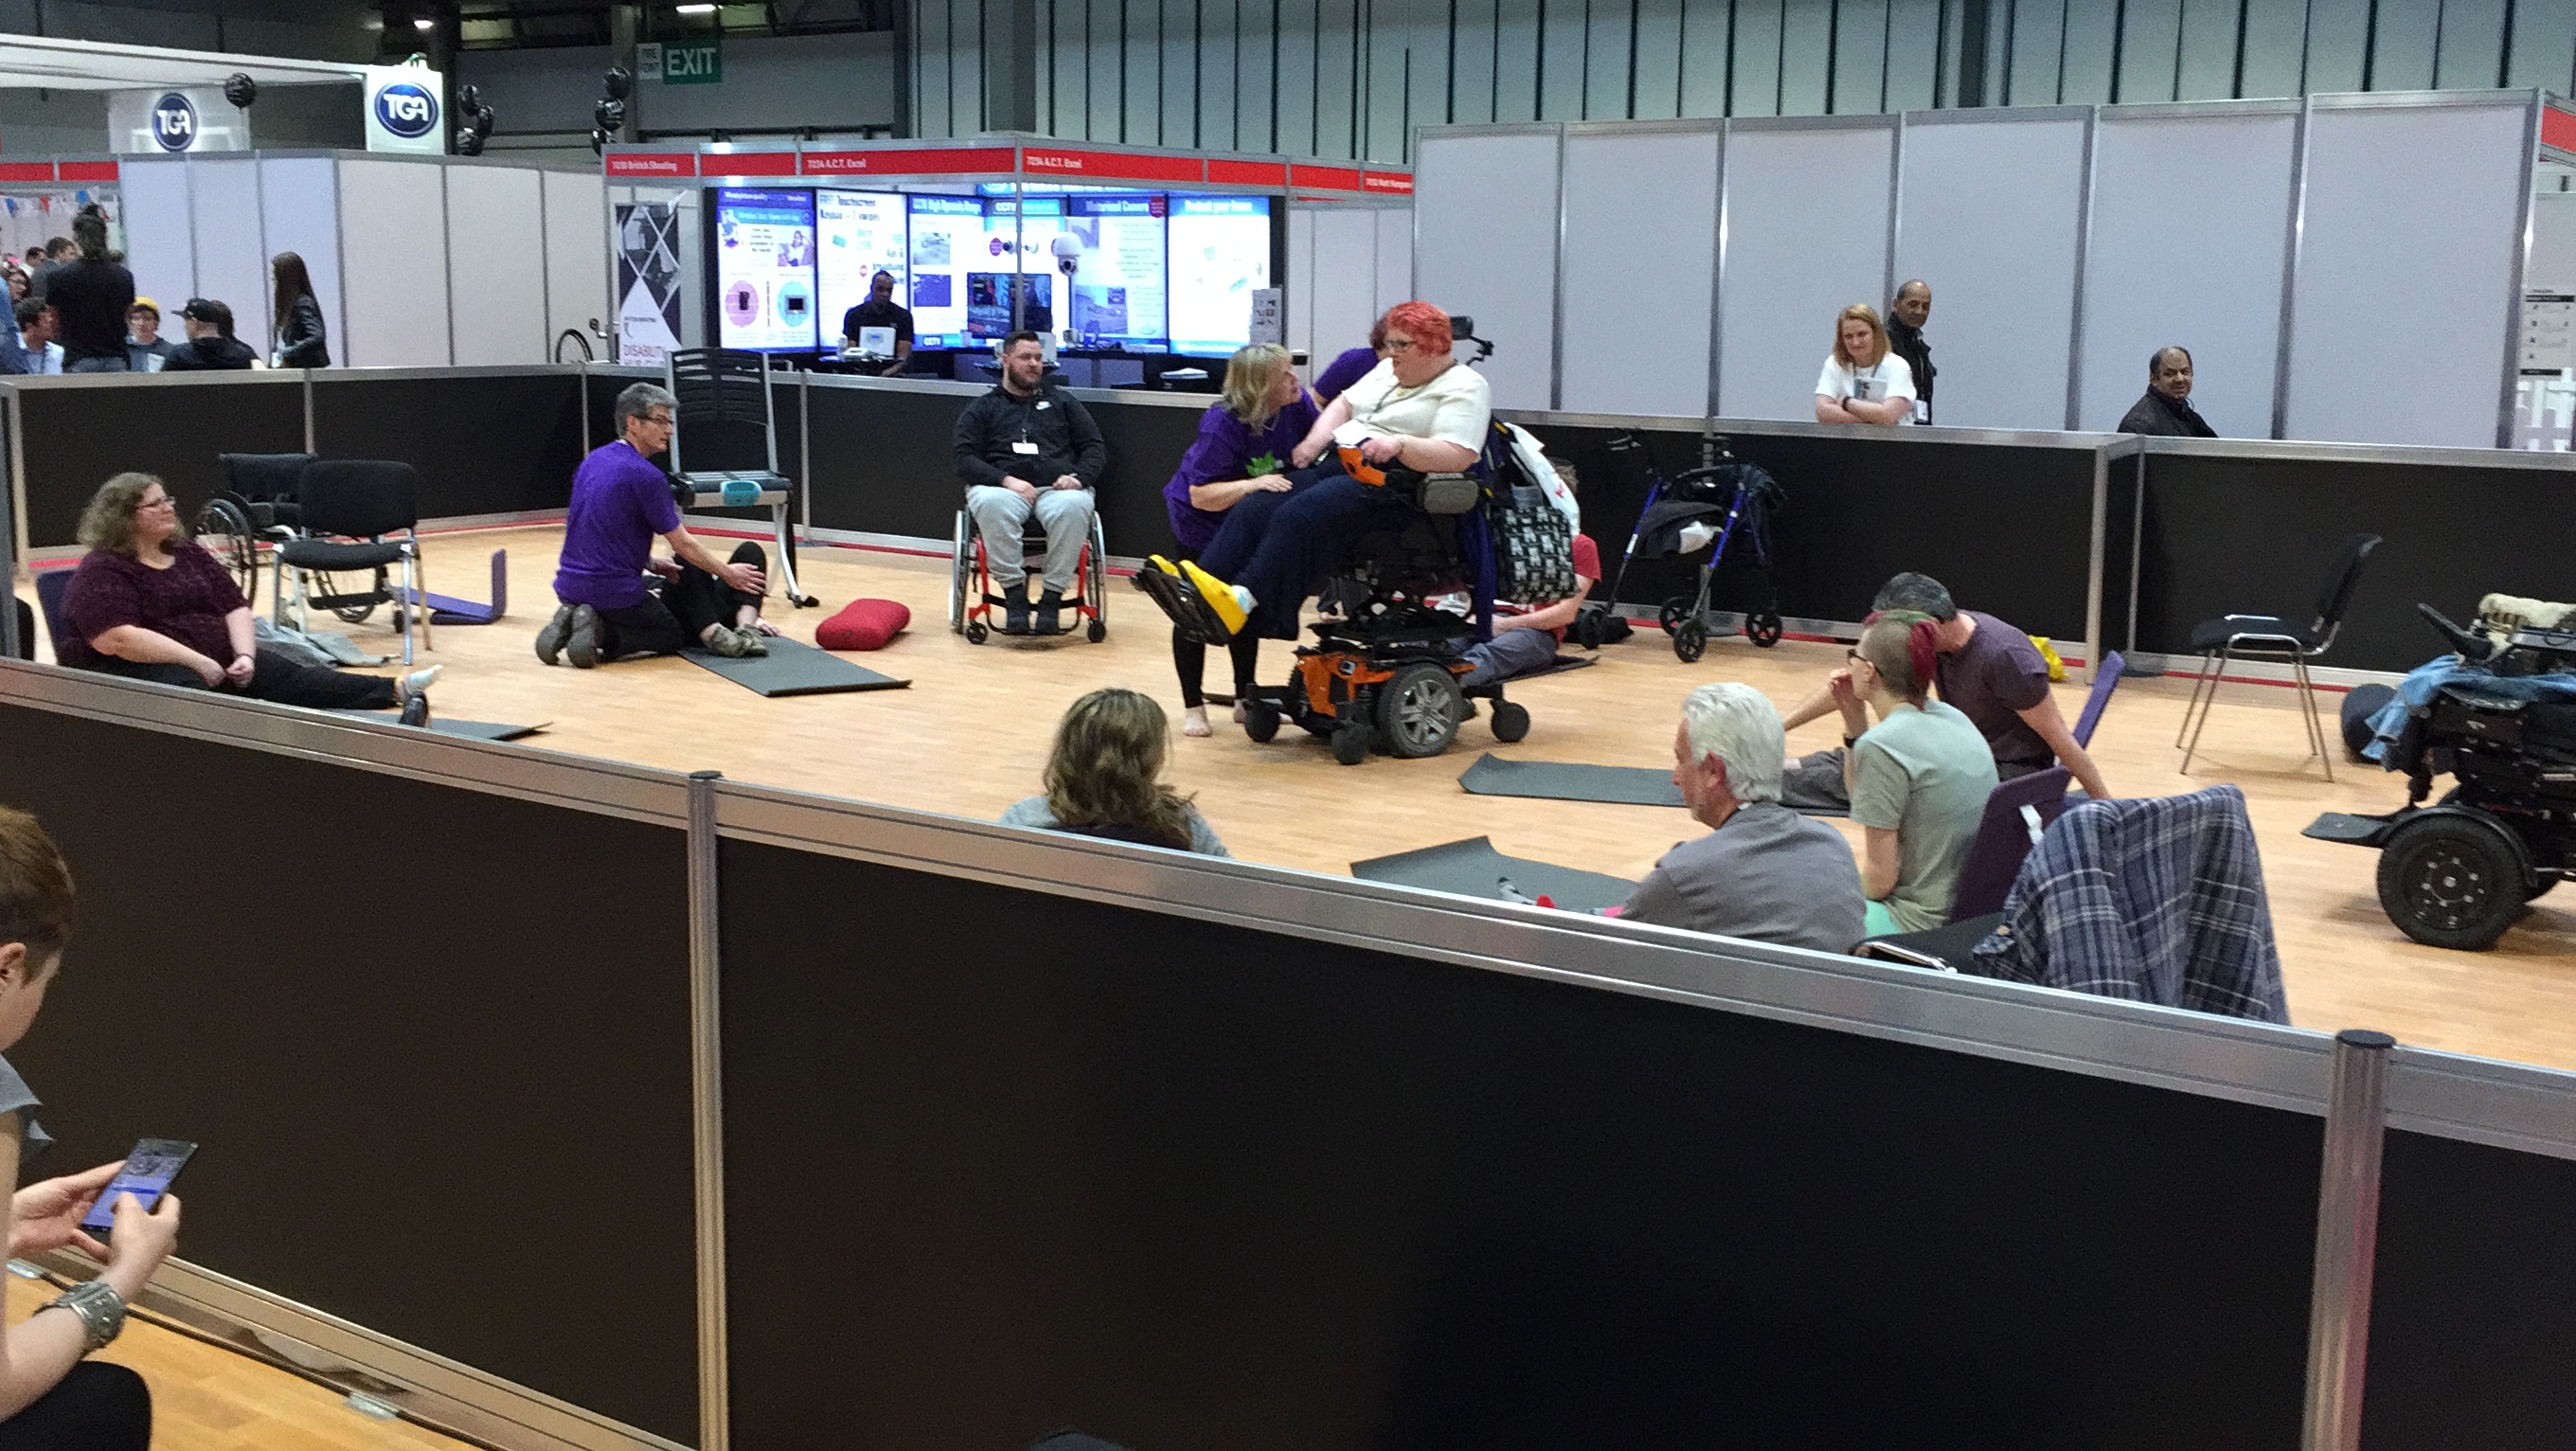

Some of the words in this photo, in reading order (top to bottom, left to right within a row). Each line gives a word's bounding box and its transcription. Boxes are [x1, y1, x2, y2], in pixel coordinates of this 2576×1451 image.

[667, 47, 717, 76] EXIT
[156, 109, 191, 134] TGA
[383, 93, 429, 122] TGA
